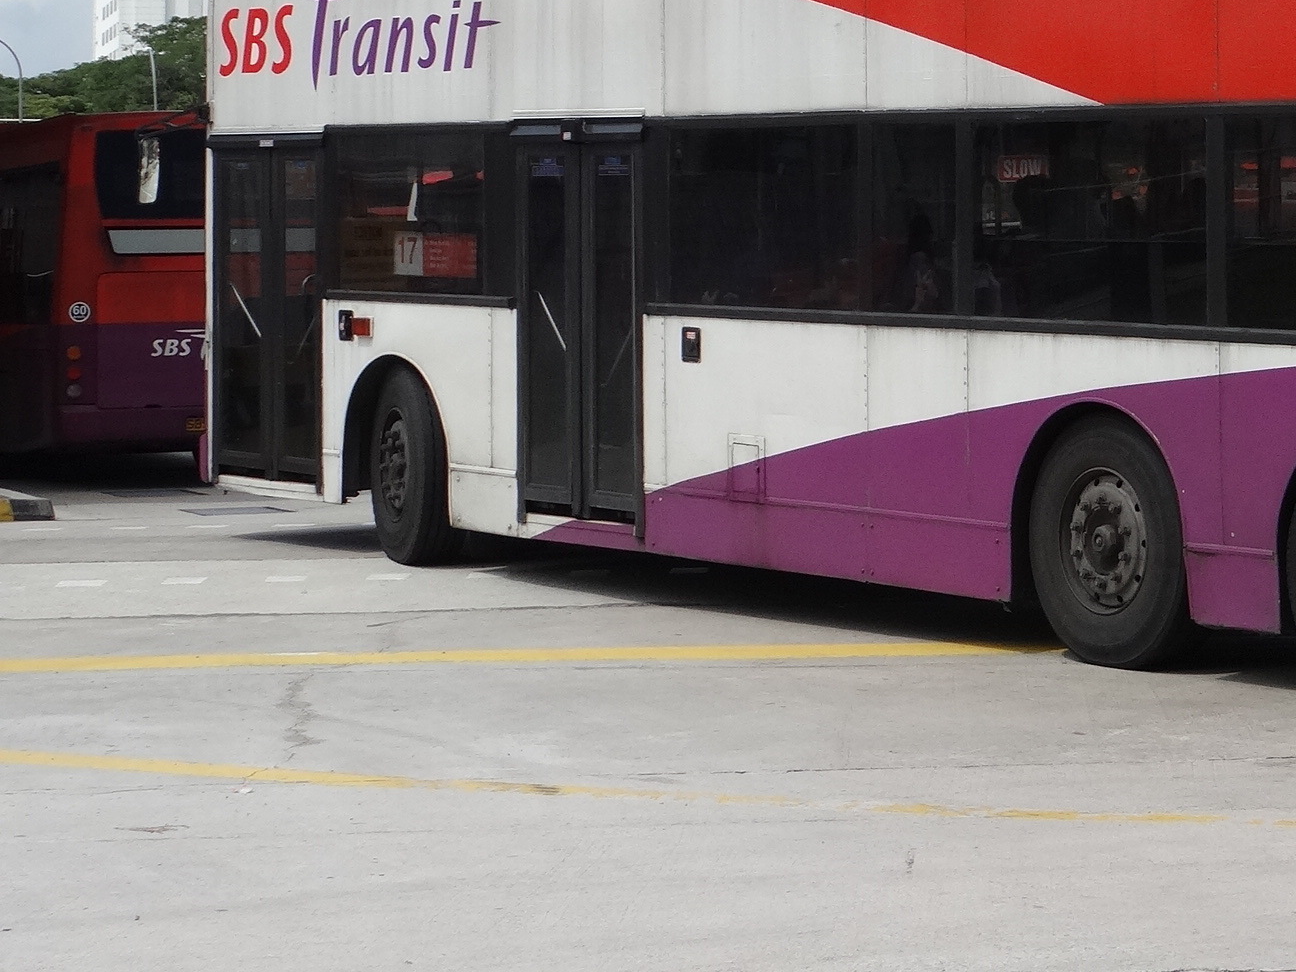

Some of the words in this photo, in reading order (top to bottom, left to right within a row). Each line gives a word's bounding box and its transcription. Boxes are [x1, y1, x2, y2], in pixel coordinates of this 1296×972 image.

[218, 4, 294, 77] SBS
[1003, 159, 1041, 179] SLOW
[398, 235, 418, 264] 17
[72, 305, 87, 316] 60
[151, 339, 192, 357] SBS
